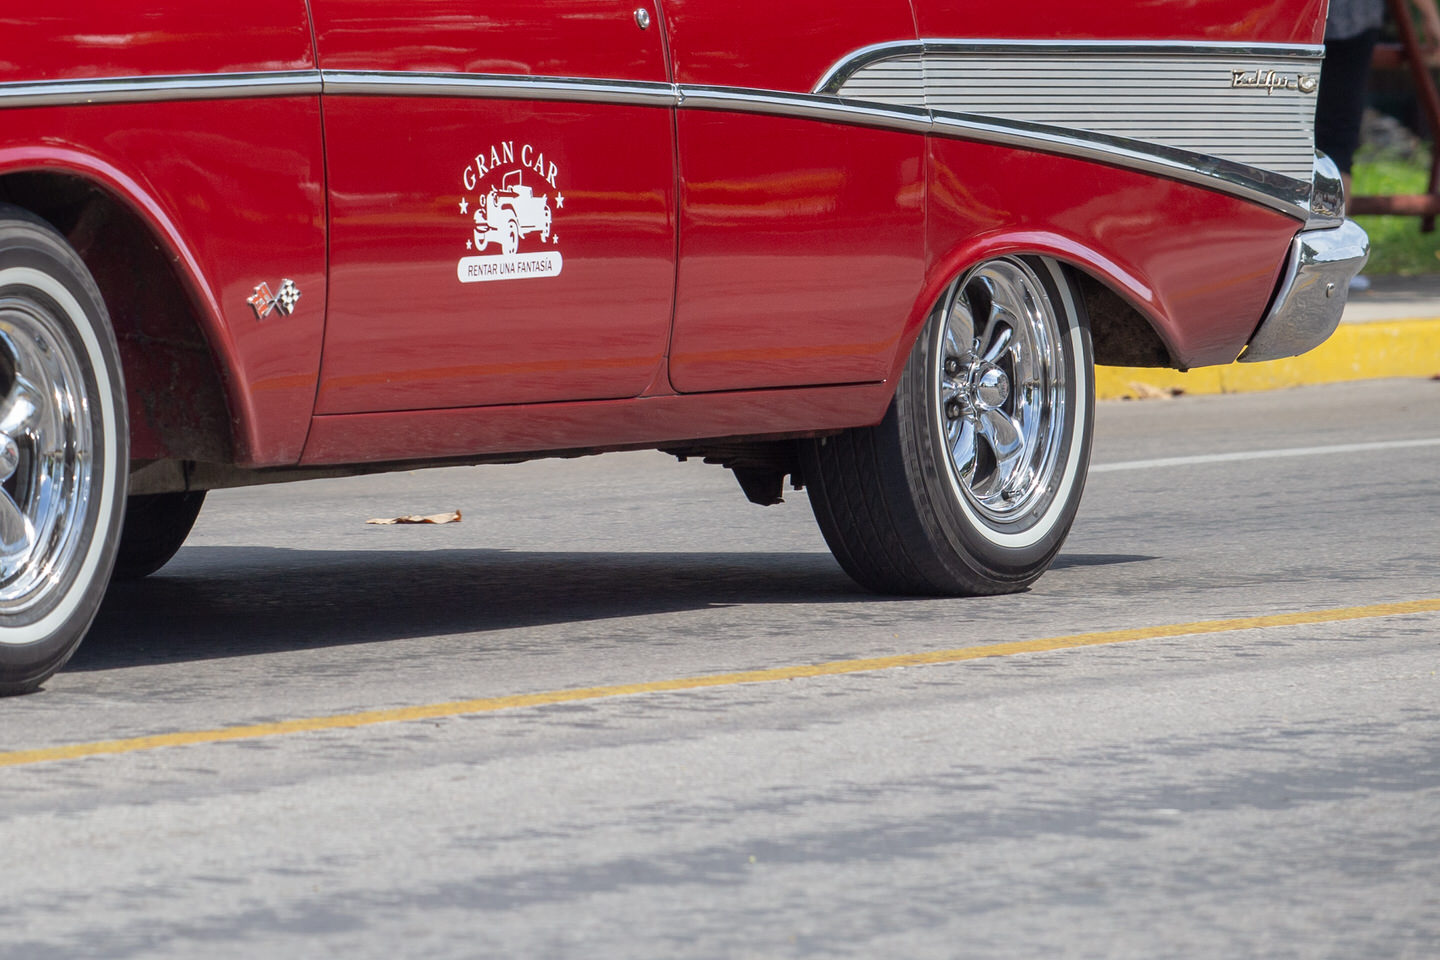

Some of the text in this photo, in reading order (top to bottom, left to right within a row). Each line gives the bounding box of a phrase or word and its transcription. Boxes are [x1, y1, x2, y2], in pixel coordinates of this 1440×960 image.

[463, 141, 558, 191] GRAN CAR
[467, 263, 498, 277] RENTAR
[499, 262, 516, 274] UNA
